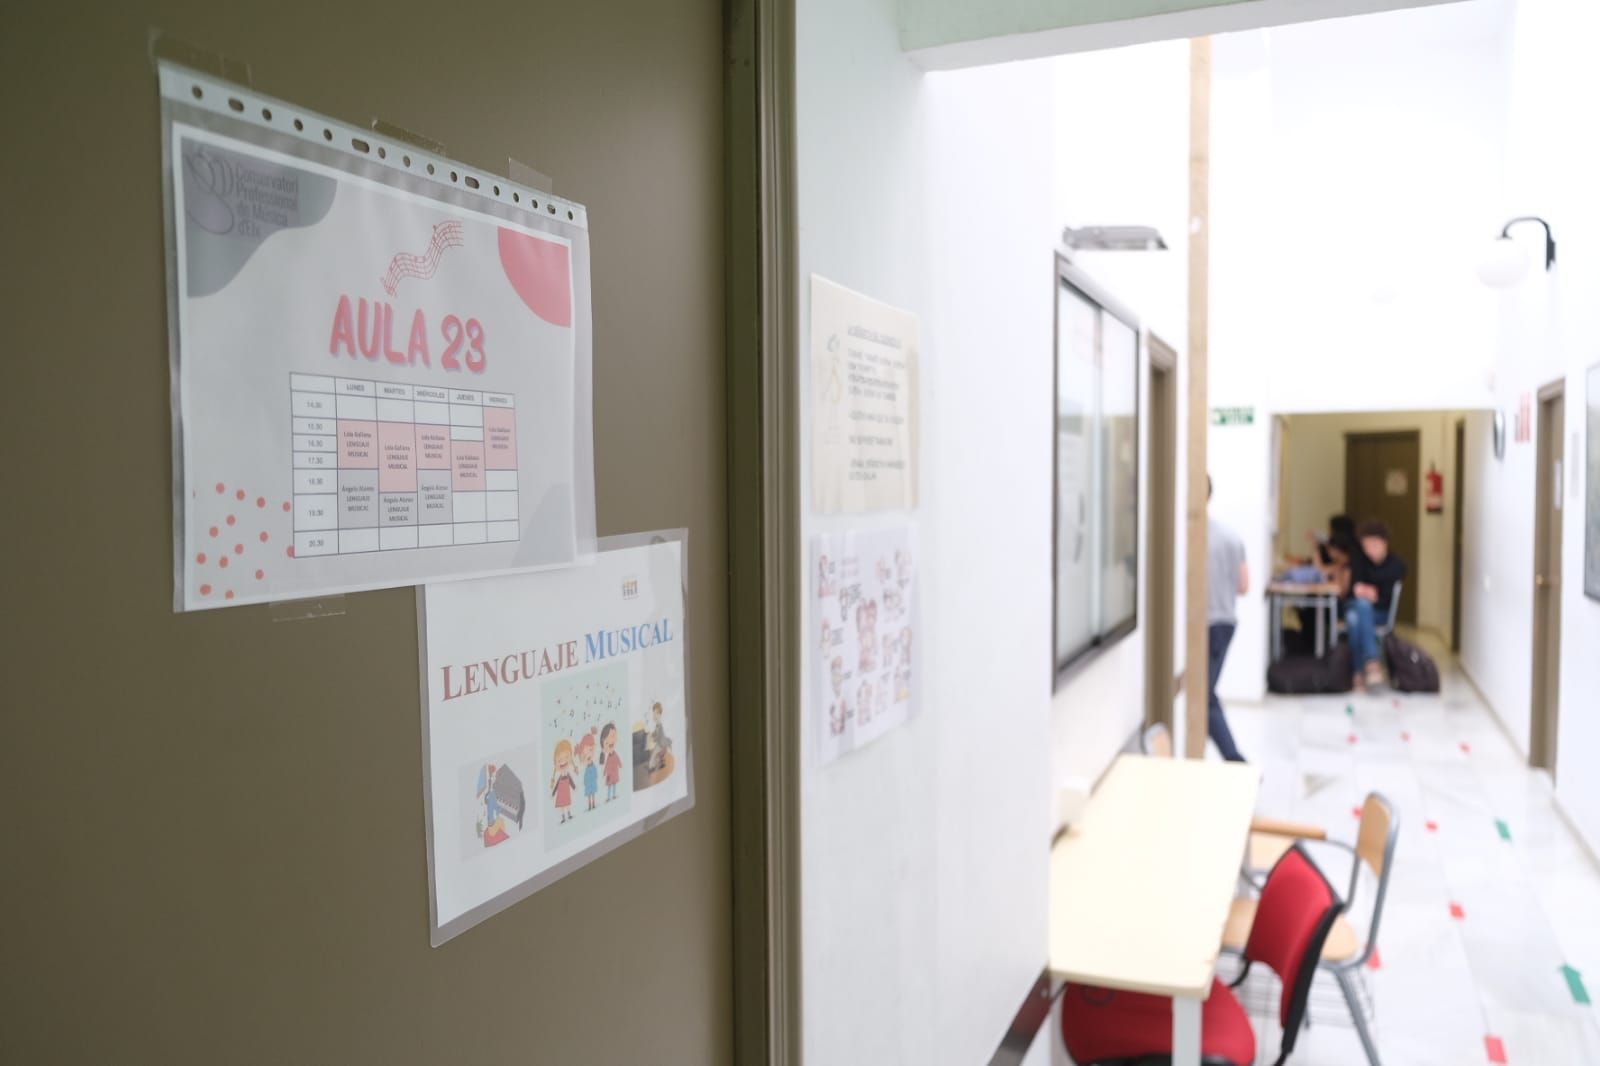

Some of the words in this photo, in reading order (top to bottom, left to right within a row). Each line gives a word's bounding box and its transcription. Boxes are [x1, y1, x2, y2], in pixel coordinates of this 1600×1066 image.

[329, 293, 433, 370] AULA
[441, 313, 487, 375] 23
[346, 384, 365, 392] LUNES
[384, 387, 406, 395] MARTES
[346, 440, 370, 448] LENGUAJE
[348, 450, 368, 458] MUSICAL
[441, 639, 580, 702] LENGUAJE
[585, 617, 674, 664] MUSICAL
